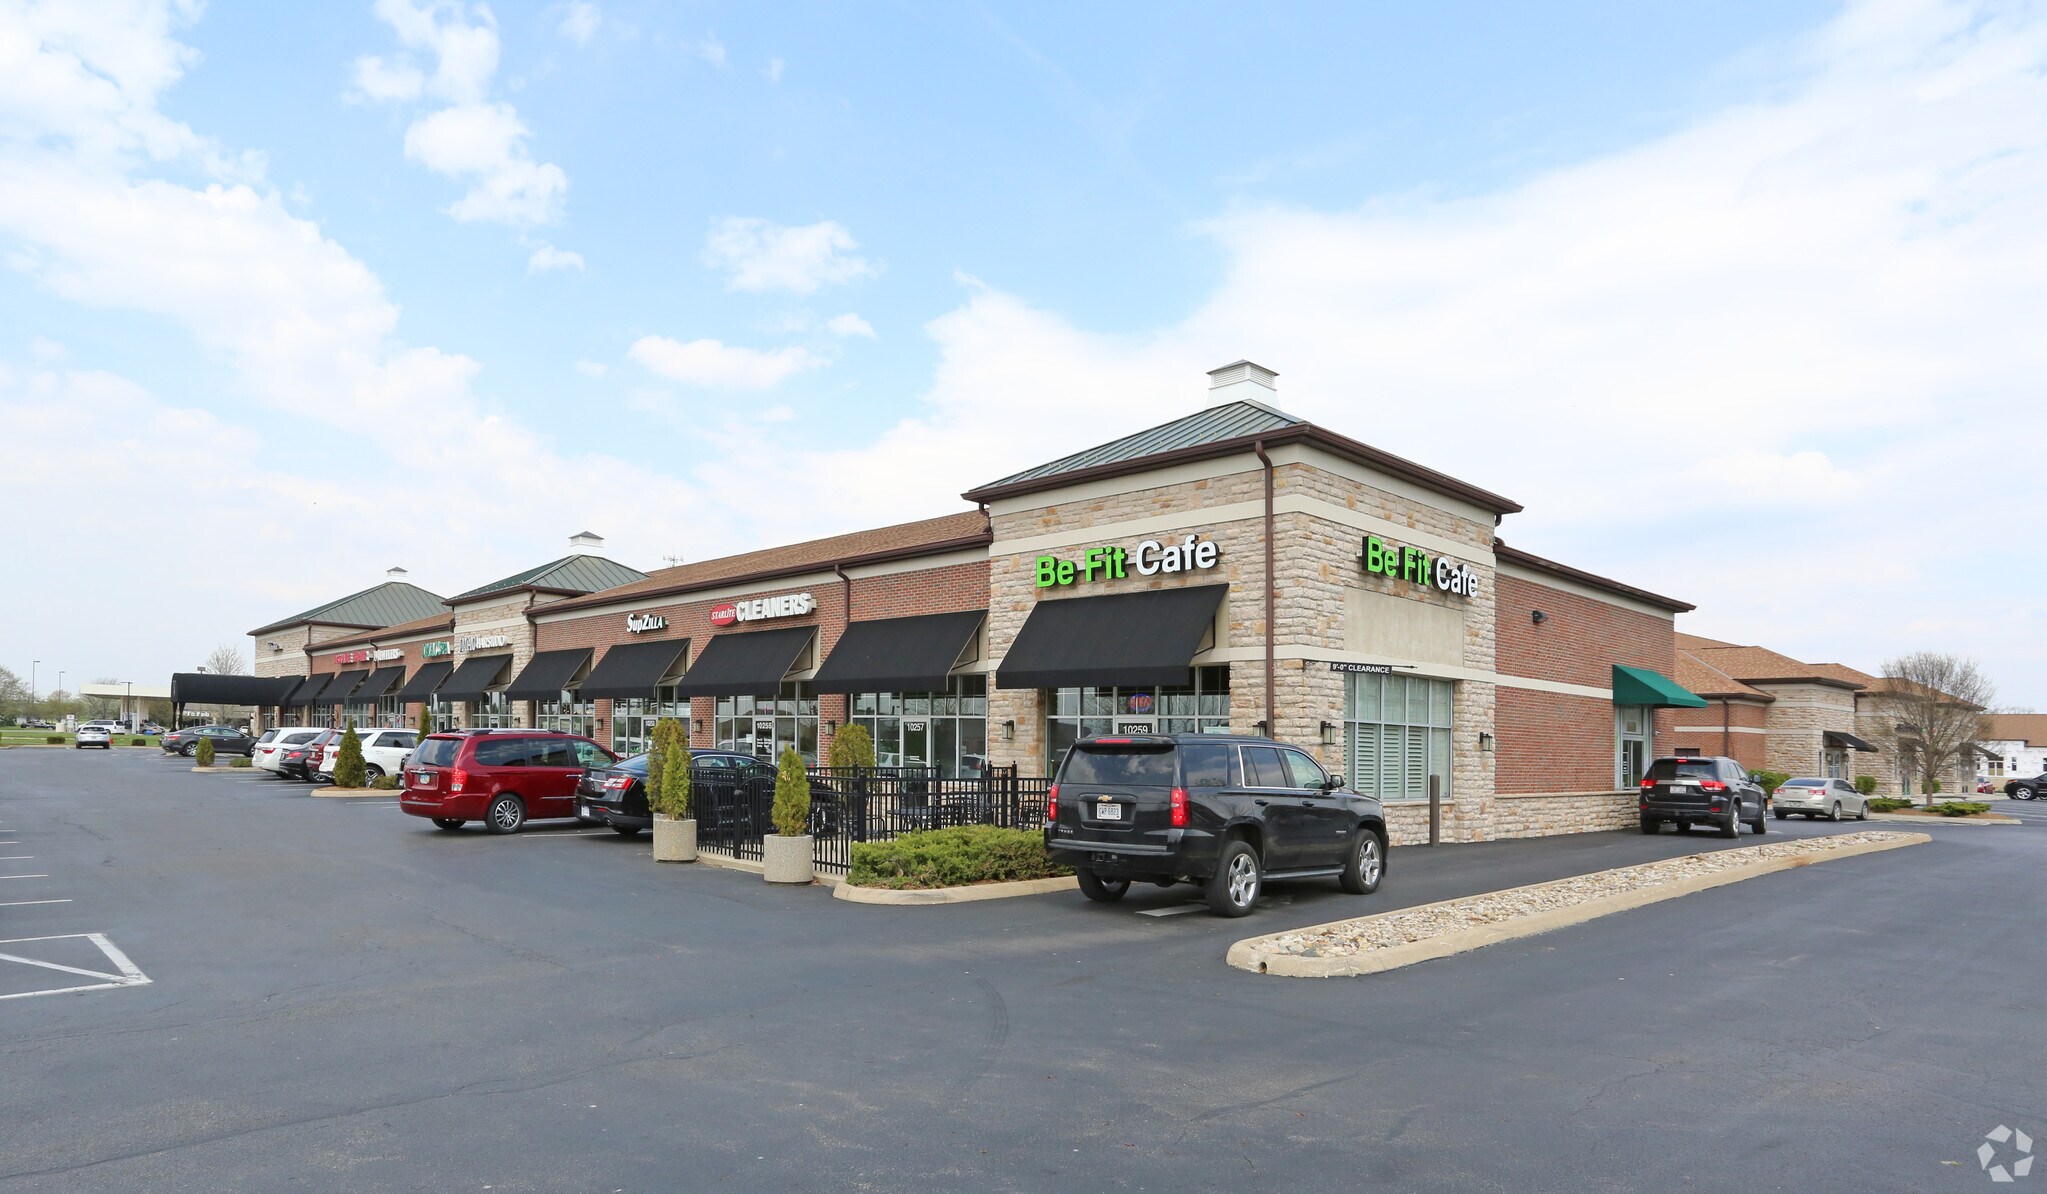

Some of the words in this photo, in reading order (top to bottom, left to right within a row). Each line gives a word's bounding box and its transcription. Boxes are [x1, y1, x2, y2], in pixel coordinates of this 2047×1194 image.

[1036, 556, 1075, 588] Be
[1085, 546, 1126, 582] Fit
[1136, 535, 1217, 576] Cafe
[1367, 535, 1397, 577] Be
[1404, 546, 1430, 586] Fit
[1436, 556, 1478, 598] Cafe
[736, 593, 812, 621] CLEANERS
[1348, 664, 1390, 674] CLEARANCE
[756, 722, 772, 730] 10255
[907, 722, 925, 732] 10257
[1123, 725, 1148, 734] 10259
